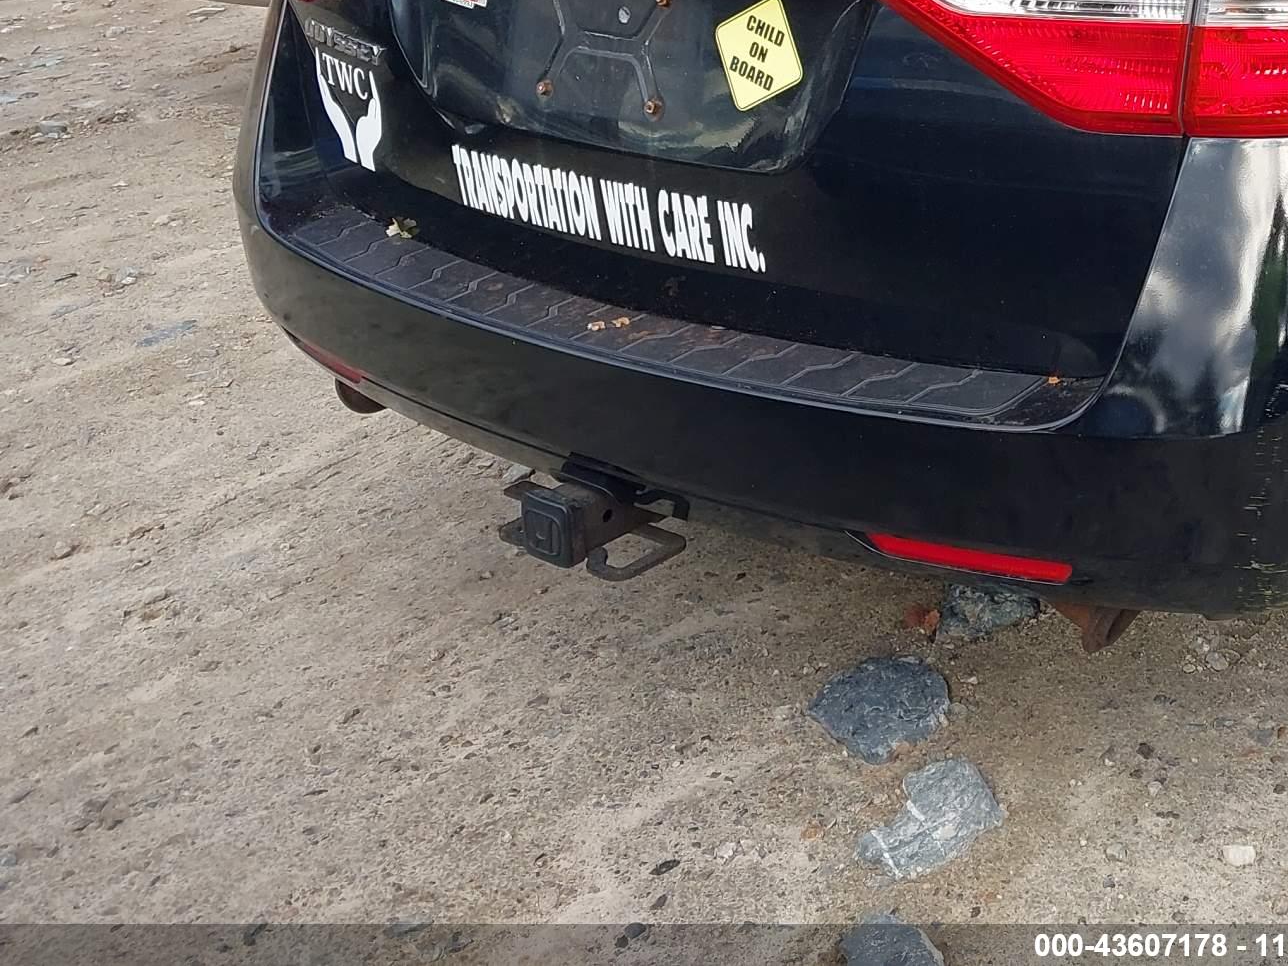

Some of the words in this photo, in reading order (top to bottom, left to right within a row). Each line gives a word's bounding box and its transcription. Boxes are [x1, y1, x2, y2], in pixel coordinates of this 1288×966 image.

[304, 18, 386, 66] ODYSSEY
[746, 15, 786, 47] CHILD
[749, 41, 769, 63] ON
[321, 52, 369, 101] TWC
[729, 55, 774, 92] BOARD
[452, 144, 601, 241] TRANSPORTATION
[600, 178, 656, 253] WITH
[657, 189, 715, 264] CARE
[717, 199, 767, 274] INC.
